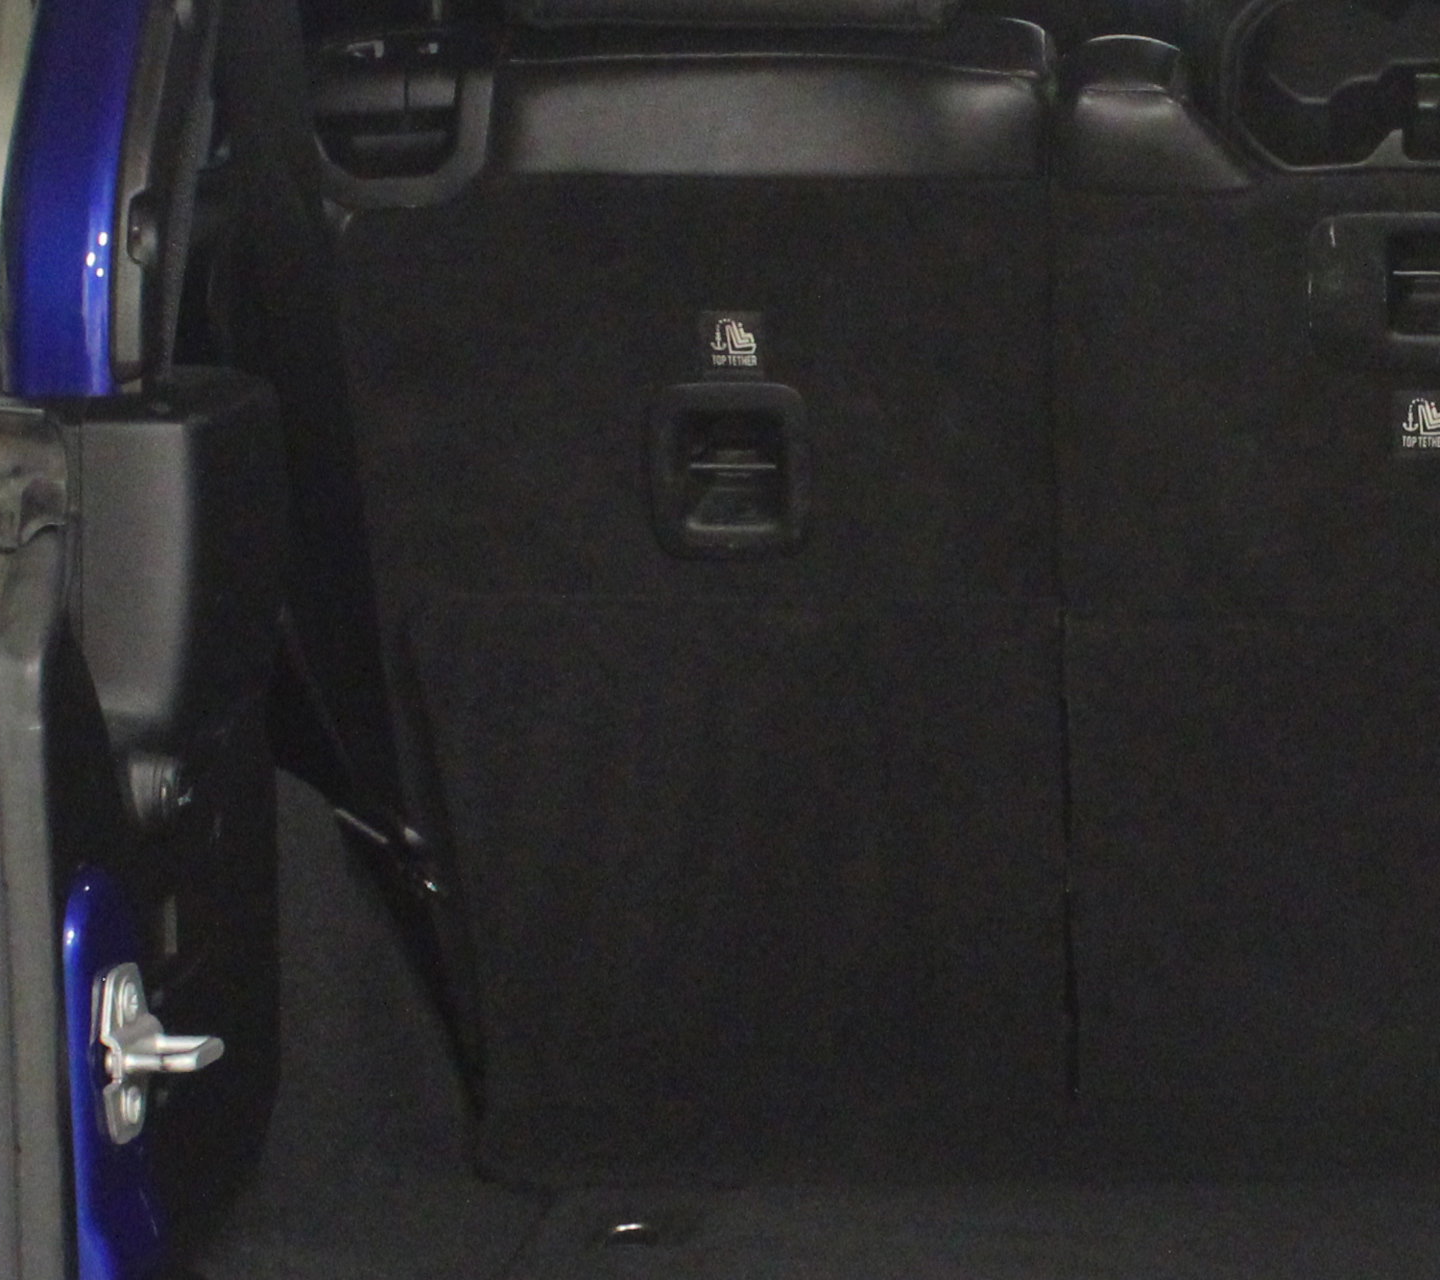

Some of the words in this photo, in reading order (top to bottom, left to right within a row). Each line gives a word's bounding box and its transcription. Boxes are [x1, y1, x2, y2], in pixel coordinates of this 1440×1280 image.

[711, 354, 727, 367] TOP
[728, 354, 758, 367] TETHER
[1402, 435, 1417, 448] TOP
